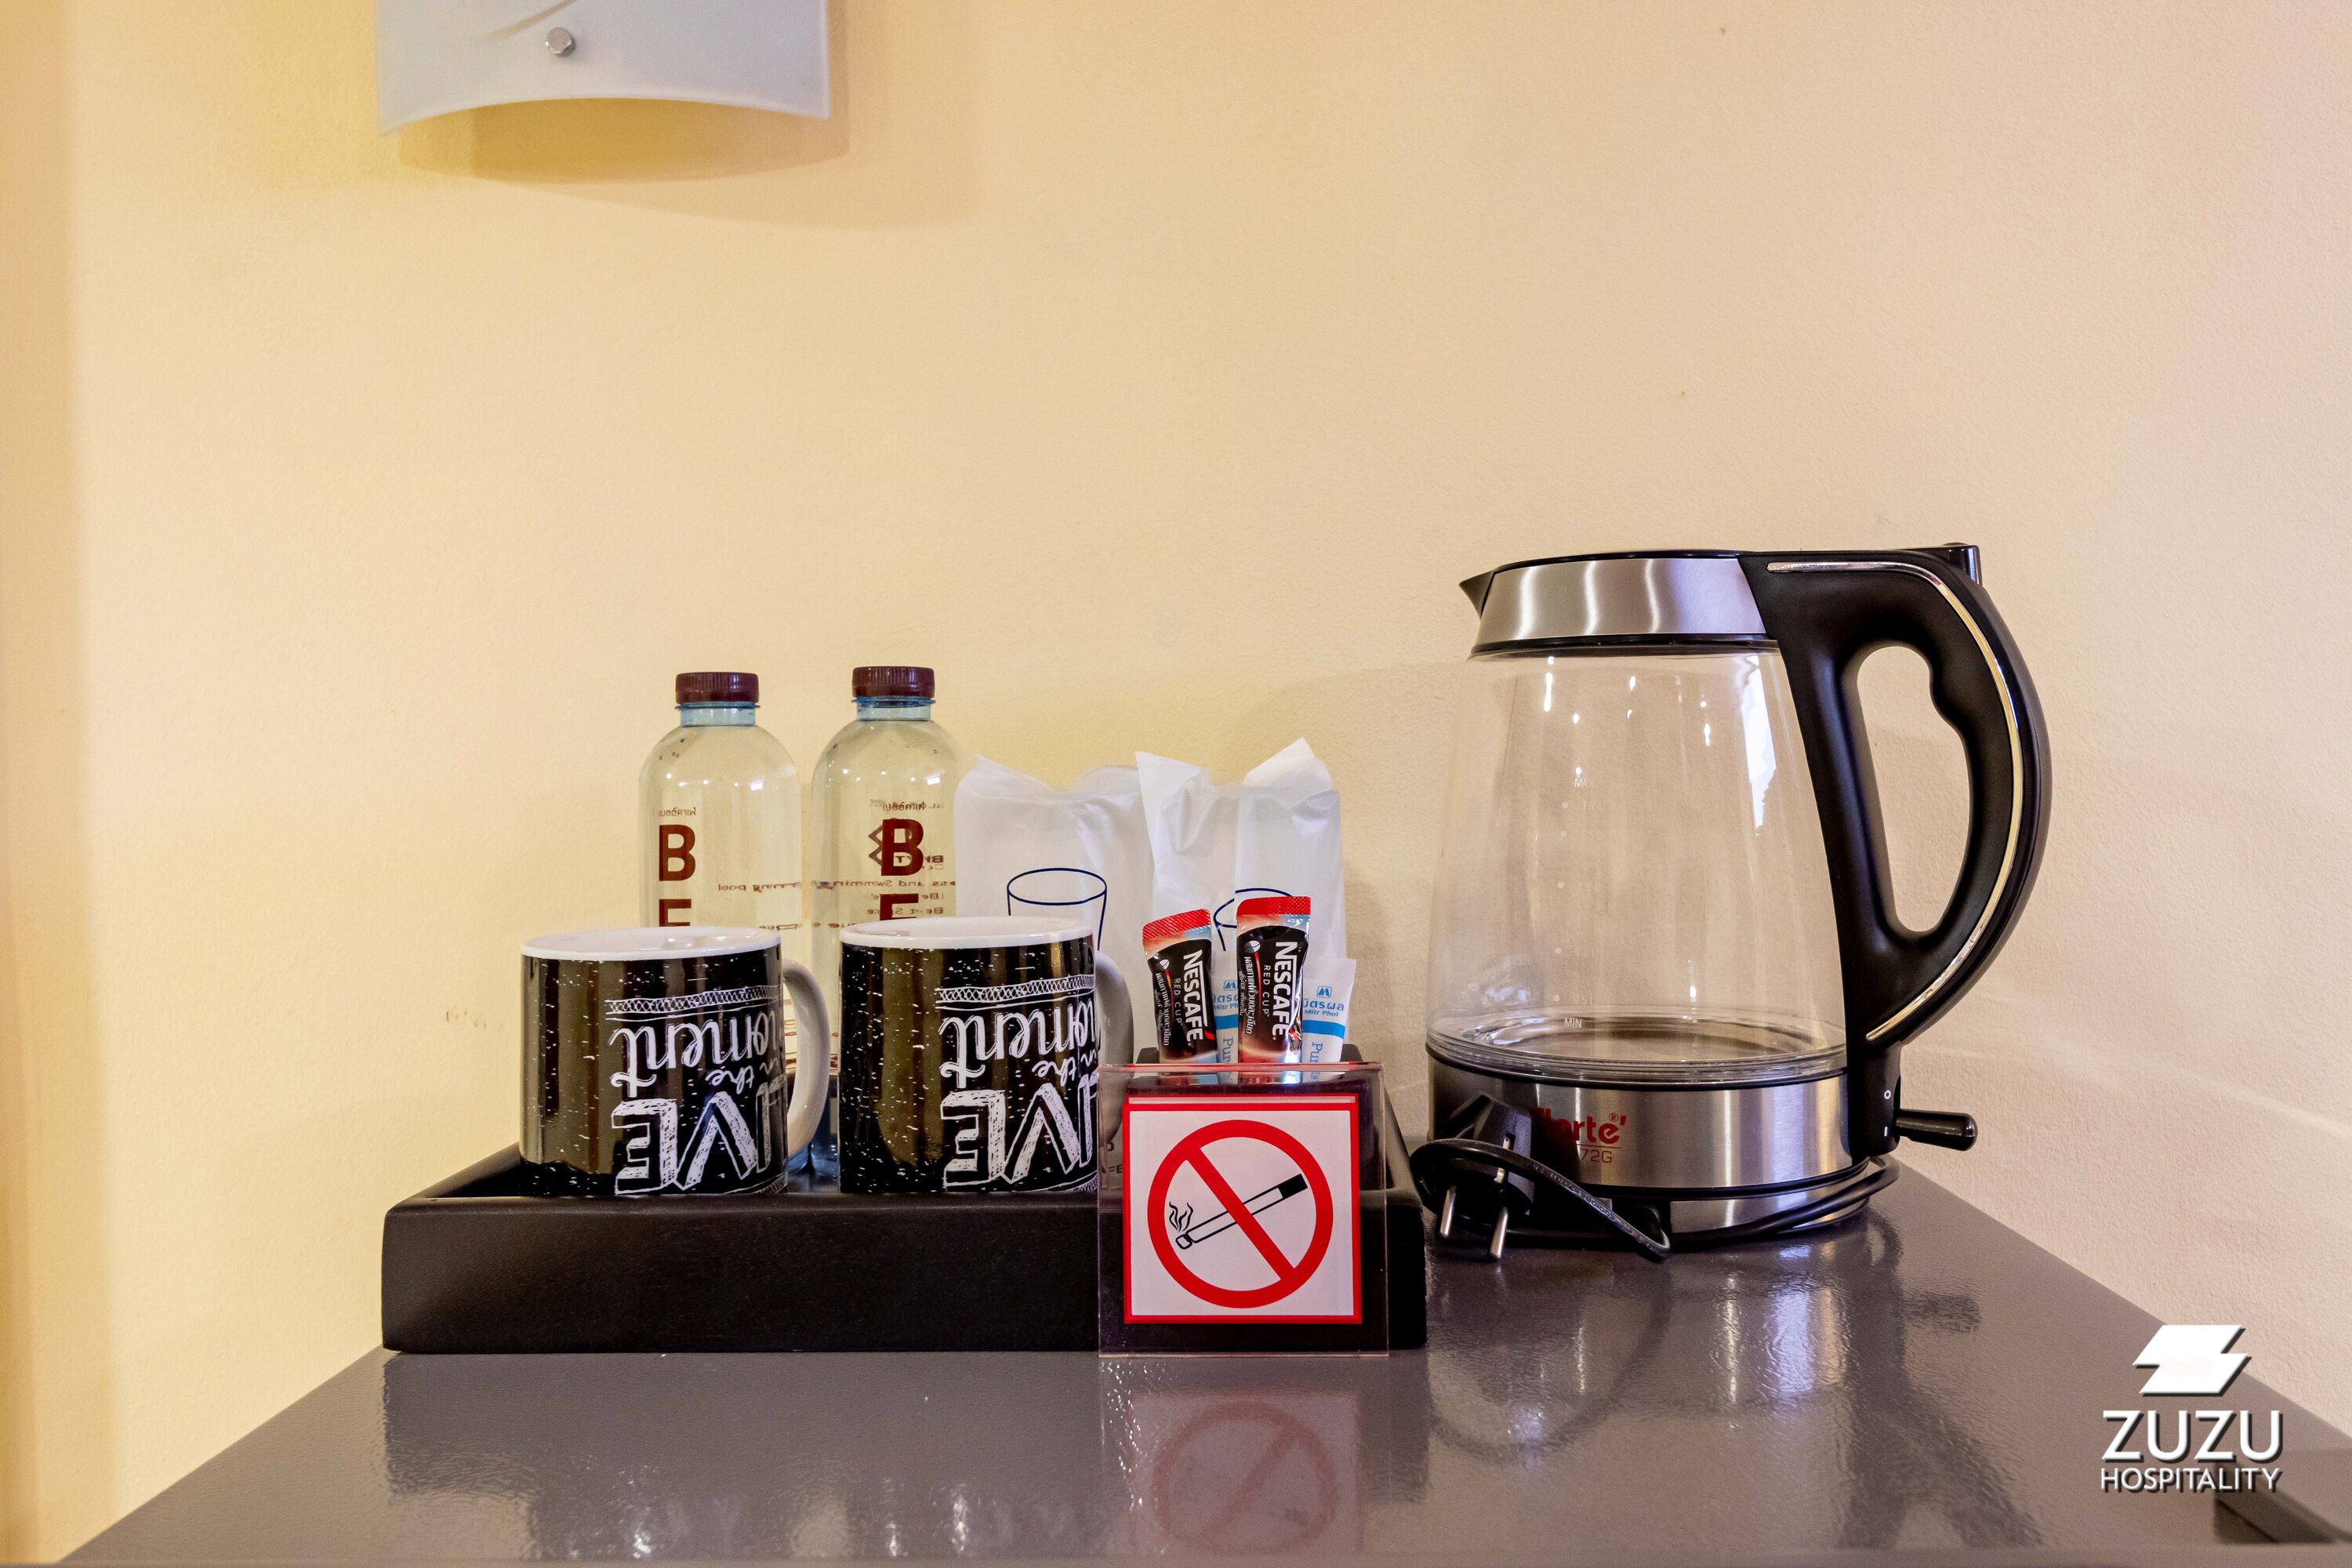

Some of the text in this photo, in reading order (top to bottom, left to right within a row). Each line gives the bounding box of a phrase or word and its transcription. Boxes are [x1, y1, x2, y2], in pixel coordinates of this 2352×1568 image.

[1263, 964, 1272, 986] RED
[1564, 1018, 1582, 1029] MIN
[705, 1063, 755, 1094] the
[1032, 1055, 1077, 1087] the
